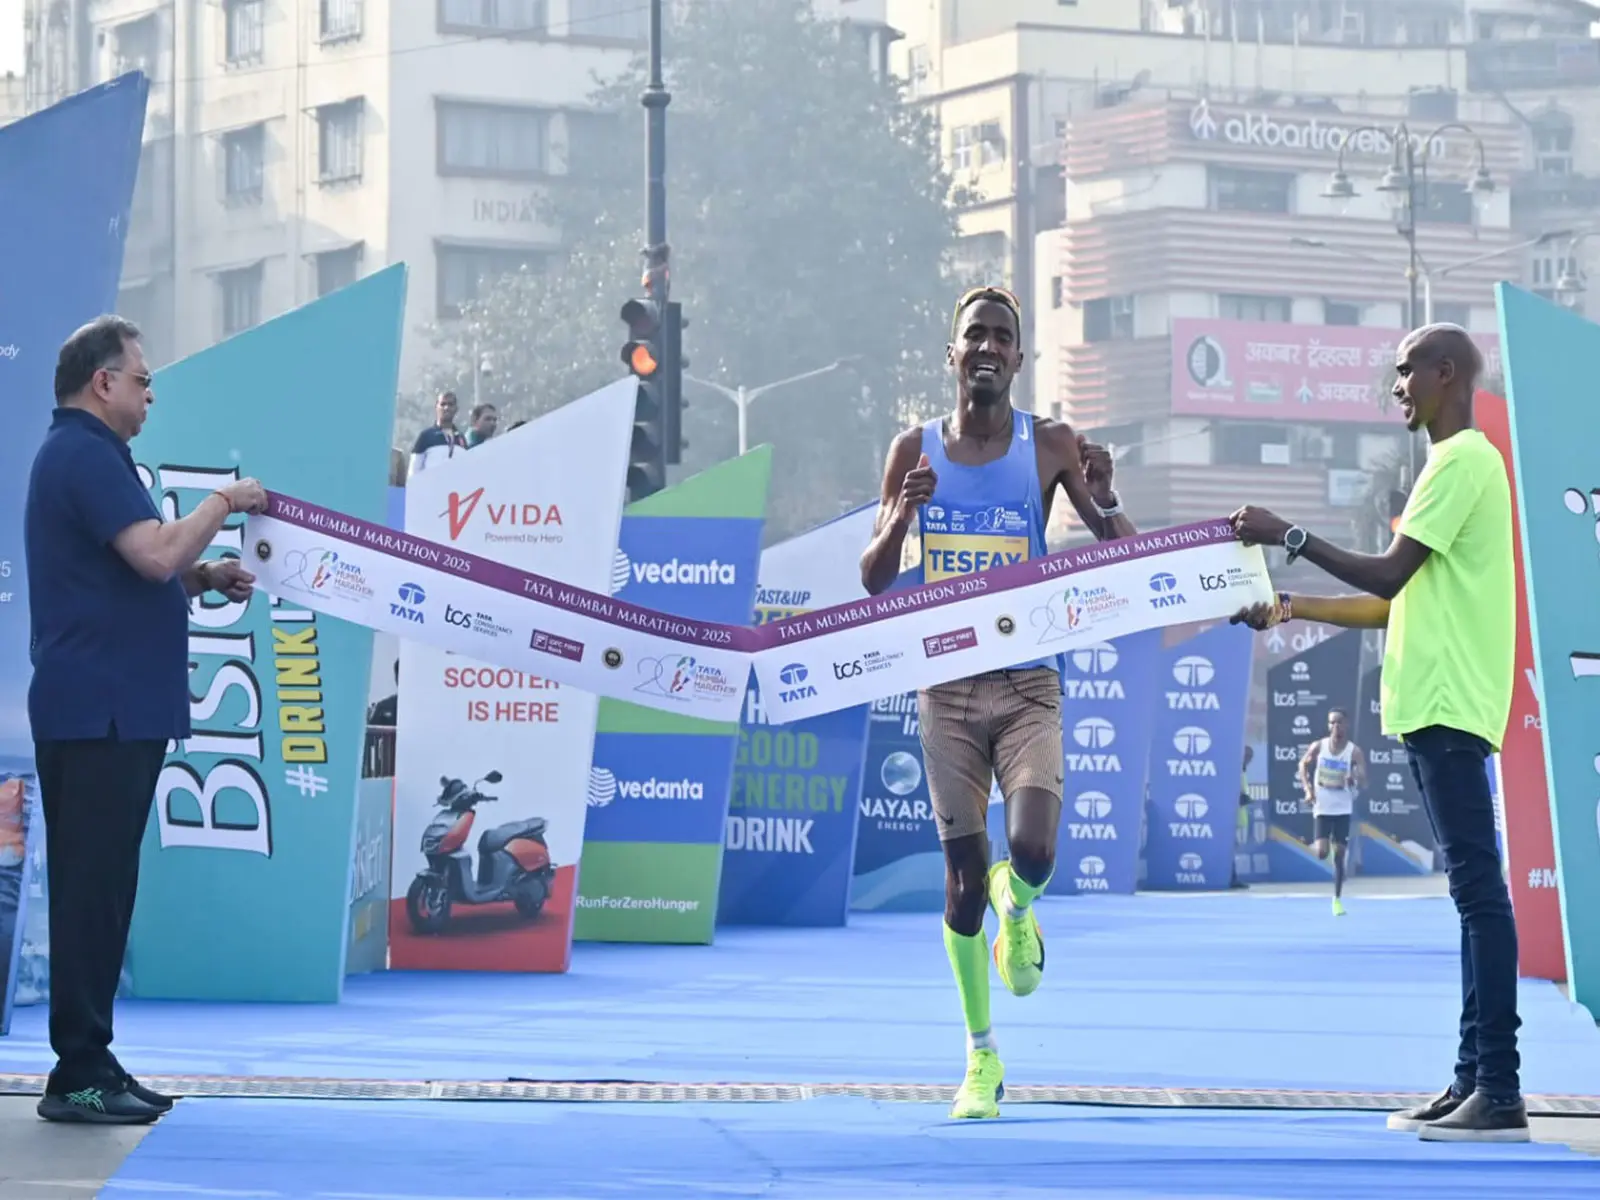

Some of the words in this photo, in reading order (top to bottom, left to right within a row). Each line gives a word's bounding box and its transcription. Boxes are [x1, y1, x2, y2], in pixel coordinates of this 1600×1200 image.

[487, 504, 563, 525] VIDA
[277, 500, 304, 521] TATA
[307, 512, 361, 538] MUMBAI
[363, 526, 441, 562] MARATHON
[443, 553, 472, 572] 2025
[926, 522, 948, 532] TATA
[485, 532, 526, 543] Powered
[527, 534, 538, 544] by
[540, 534, 563, 543] Hero
[1038, 556, 1073, 576] TATA
[1076, 542, 1130, 566] MUMBAI
[1134, 525, 1209, 553] MARATHON
[1213, 525, 1234, 538] 202
[339, 561, 362, 575] TATA
[633, 558, 735, 584] vedanta
[1083, 587, 1108, 597] TATA
[1199, 573, 1227, 592] tcs
[756, 588, 811, 606] AST&UP
[1149, 593, 1187, 609] TATA
[389, 603, 425, 624] TATA
[445, 604, 472, 629] tcs
[523, 579, 553, 598] TATA
[558, 591, 613, 617] MUMBAI
[617, 608, 699, 638] MARATHON
[701, 629, 732, 644] 2025
[778, 623, 812, 639] TATA
[815, 605, 872, 629] MUMBAI
[876, 587, 956, 614] MARATHON
[959, 578, 988, 594] 2025
[698, 665, 722, 676] TATA
[833, 660, 863, 680] tcs
[778, 685, 818, 704] TATA
[1065, 680, 1125, 699] TATA
[1165, 692, 1220, 710] TATA
[468, 701, 489, 722] IS
[495, 701, 559, 722] HERE
[735, 729, 818, 769] GOOD
[1066, 754, 1122, 772] TATA
[1166, 760, 1217, 776] TATA
[619, 777, 703, 800] vedanta
[730, 772, 848, 813] ENERGY
[727, 816, 814, 854] DRINK
[877, 821, 921, 832] ENERGY
[1068, 824, 1117, 840] TATA
[1169, 823, 1213, 838] TATA
[1074, 878, 1109, 890] TATA
[1176, 873, 1206, 884] TATA
